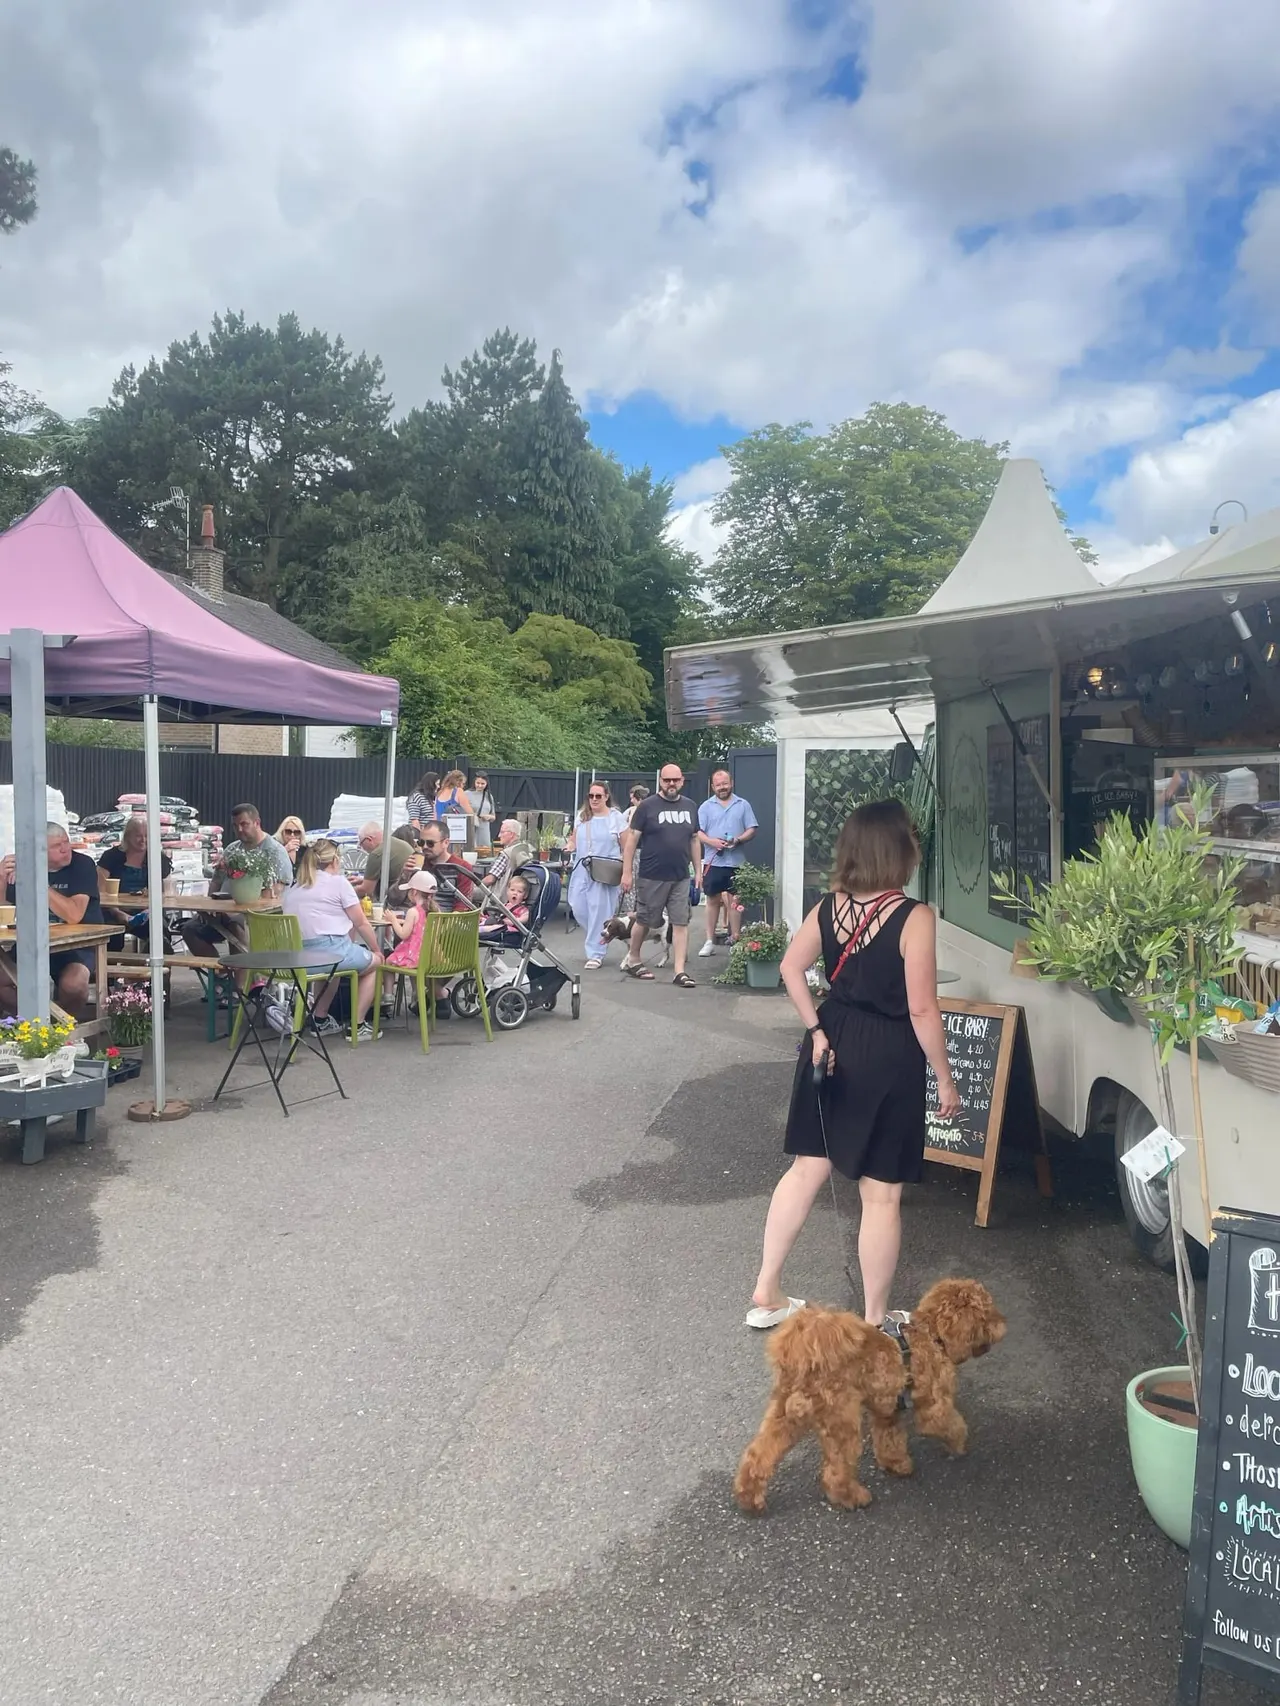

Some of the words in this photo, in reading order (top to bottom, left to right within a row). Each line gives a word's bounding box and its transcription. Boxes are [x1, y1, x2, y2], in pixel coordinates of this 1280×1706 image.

[947, 1015, 964, 1033] ICE
[964, 1016, 988, 1038] BABY
[1212, 1609, 1249, 1644] follow
